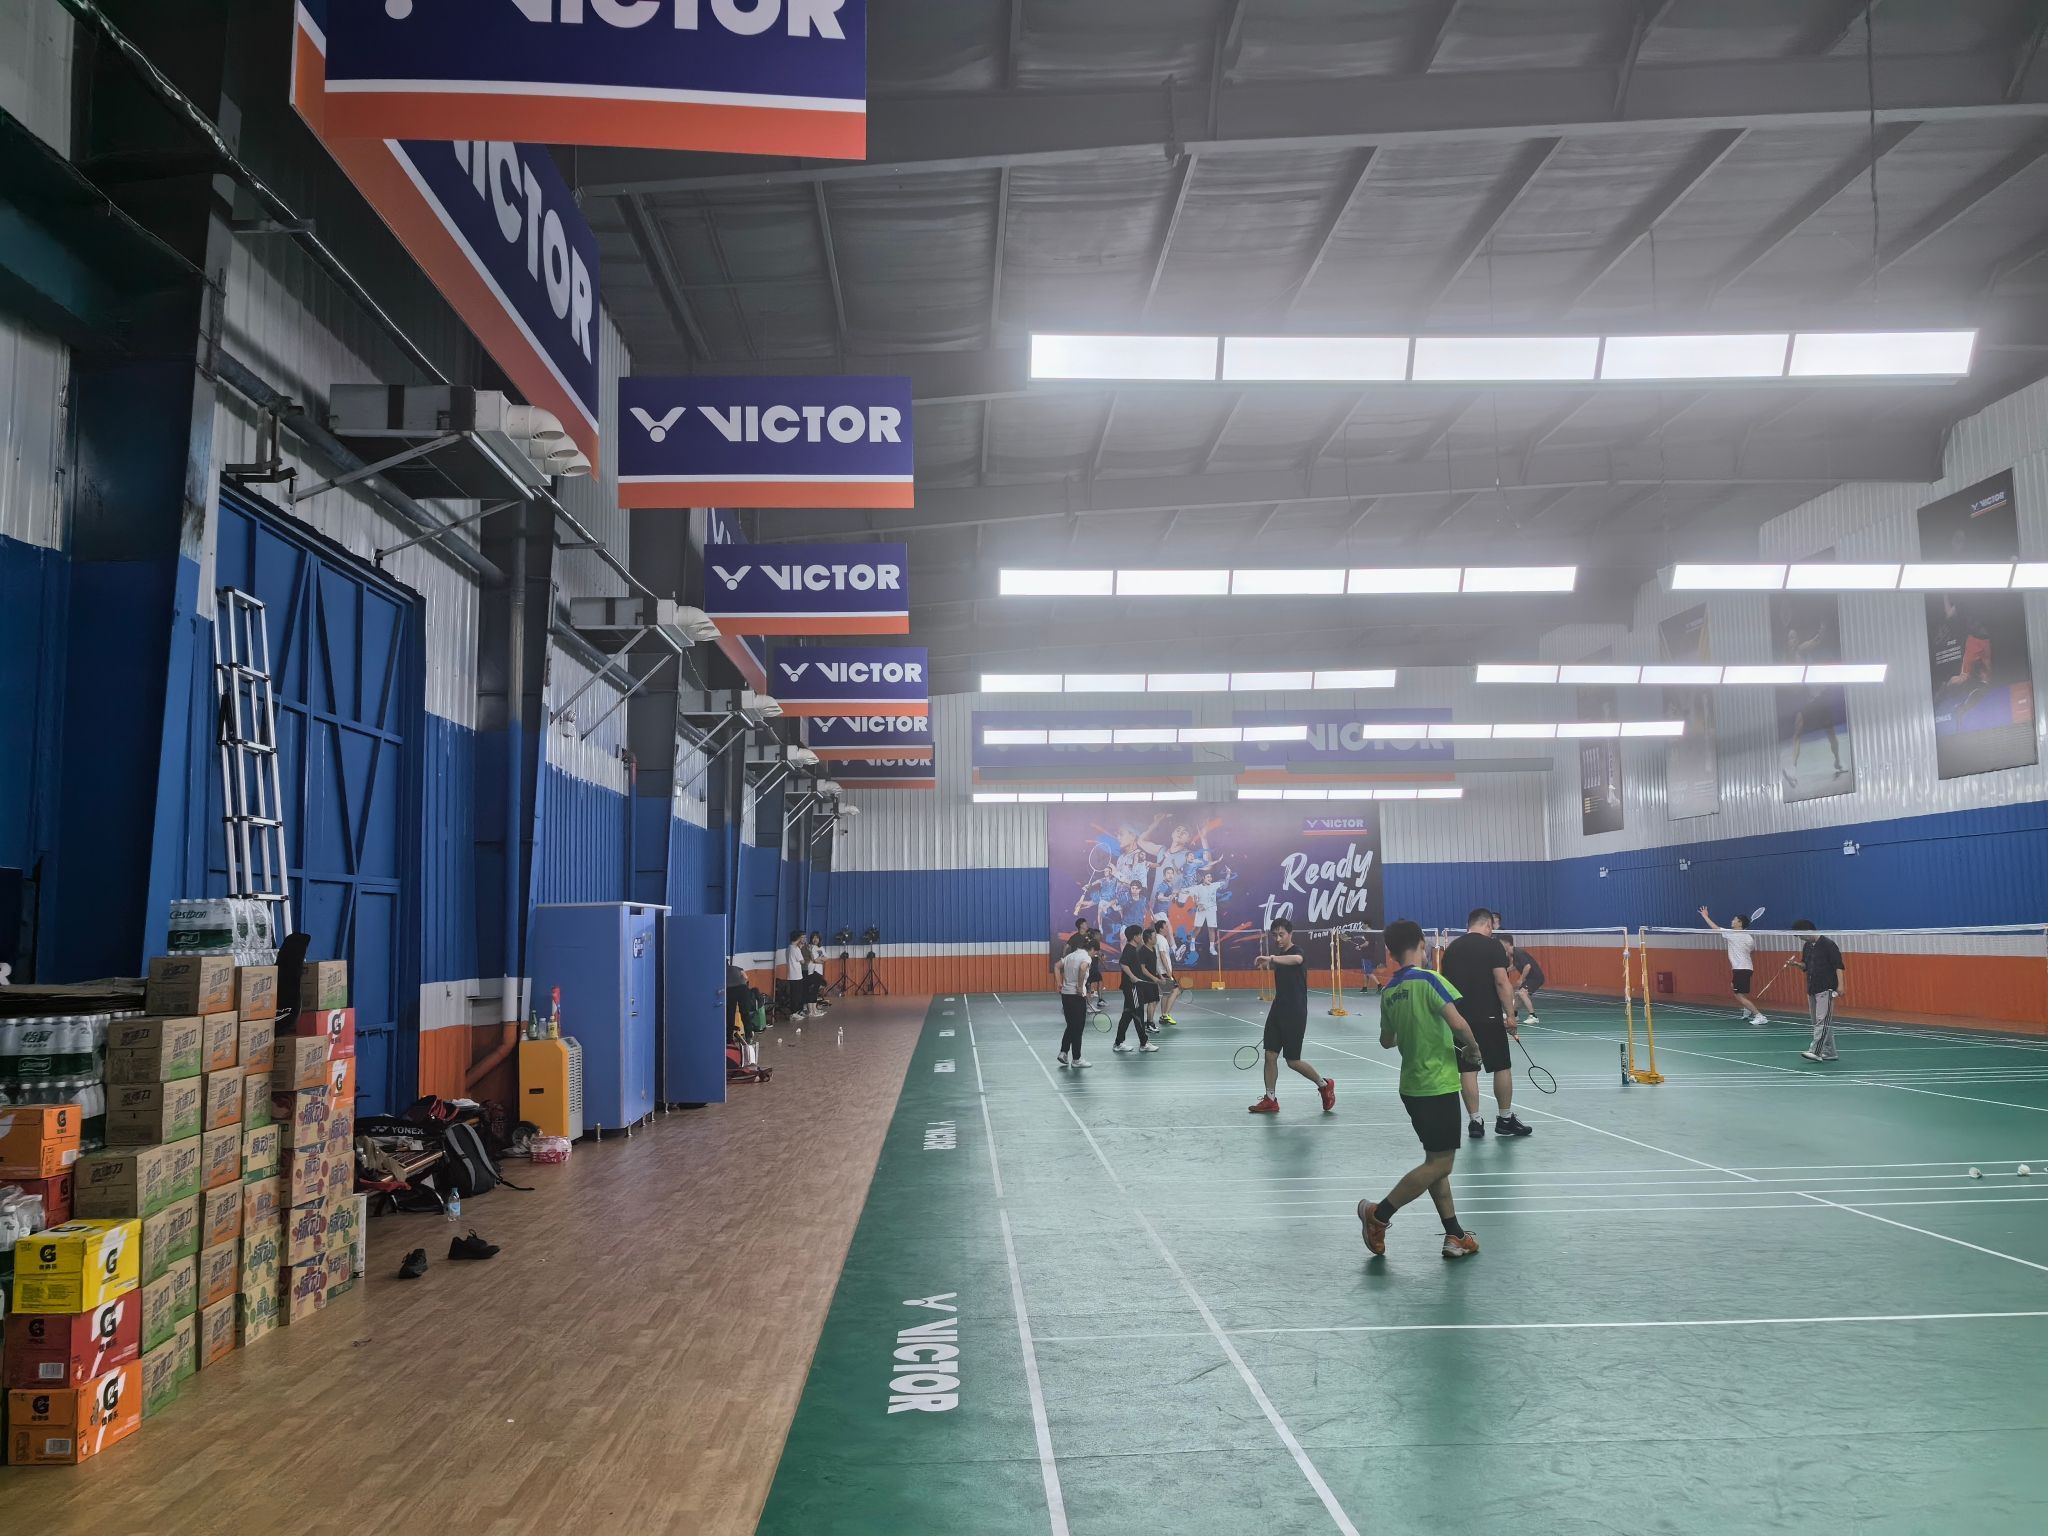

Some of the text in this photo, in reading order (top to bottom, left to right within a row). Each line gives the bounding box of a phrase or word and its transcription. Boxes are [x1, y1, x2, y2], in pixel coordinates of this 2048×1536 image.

[697, 405, 902, 443] VICTOR
[760, 563, 900, 592] VICTOR
[815, 661, 922, 683] VICTOR
[842, 716, 928, 733] VICTOR
[1321, 819, 1364, 828] VICTOR
[1280, 843, 1373, 893] Ready
[1308, 882, 1367, 923] Win
[332, 1013, 342, 1034] G
[335, 1074, 343, 1091] G
[392, 1126, 424, 1135] YONEX
[40, 1244, 57, 1262] G
[106, 1248, 118, 1274] G
[100, 1305, 117, 1337] G
[887, 1317, 960, 1415] VICTOR
[33, 1396, 50, 1414] G
[103, 1377, 119, 1411] G
